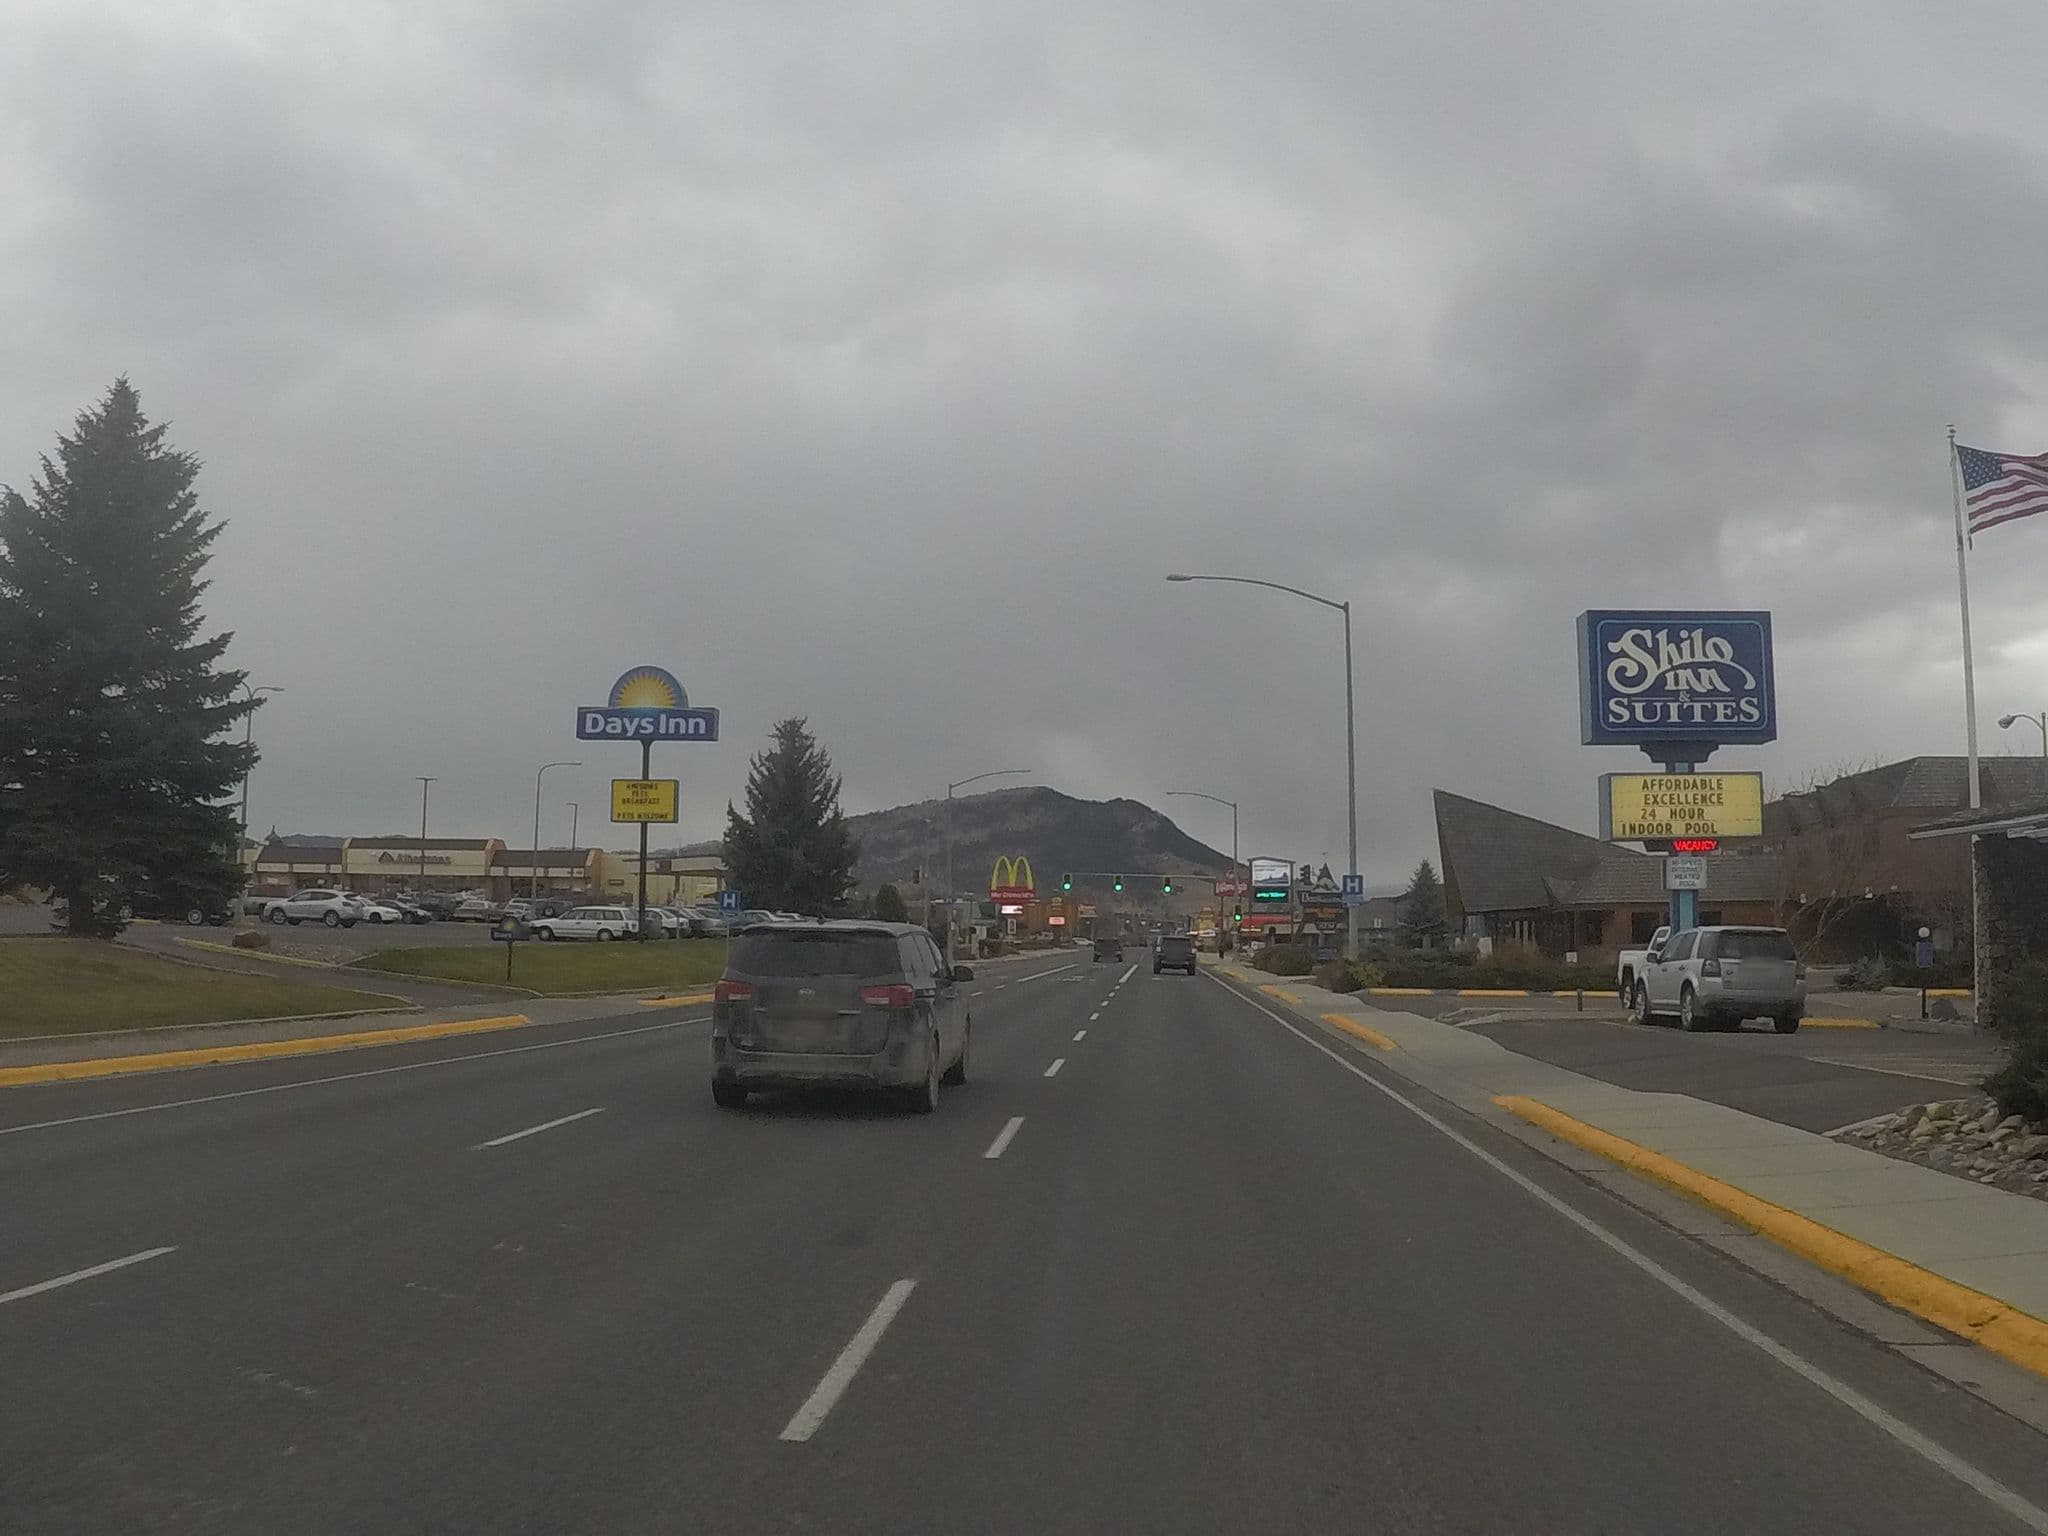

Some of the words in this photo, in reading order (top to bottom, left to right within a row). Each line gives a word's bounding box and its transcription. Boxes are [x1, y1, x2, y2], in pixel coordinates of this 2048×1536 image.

[1606, 628, 1756, 694] Shilo
[1678, 690, 1691, 702] &
[1608, 697, 1760, 723] SUITES
[584, 713, 654, 737] Days
[659, 714, 706, 734] Inn
[1641, 778, 1724, 791] AFFORDABLE
[1644, 792, 1724, 805] EXCELLENCE
[1640, 808, 1657, 820] 24
[1670, 808, 1705, 820] HOUR
[1622, 823, 1673, 835] INDOOR
[1685, 822, 1718, 835] POOL
[1673, 840, 1718, 851] VACANCY
[1346, 877, 1360, 893] H
[723, 892, 736, 908] H
